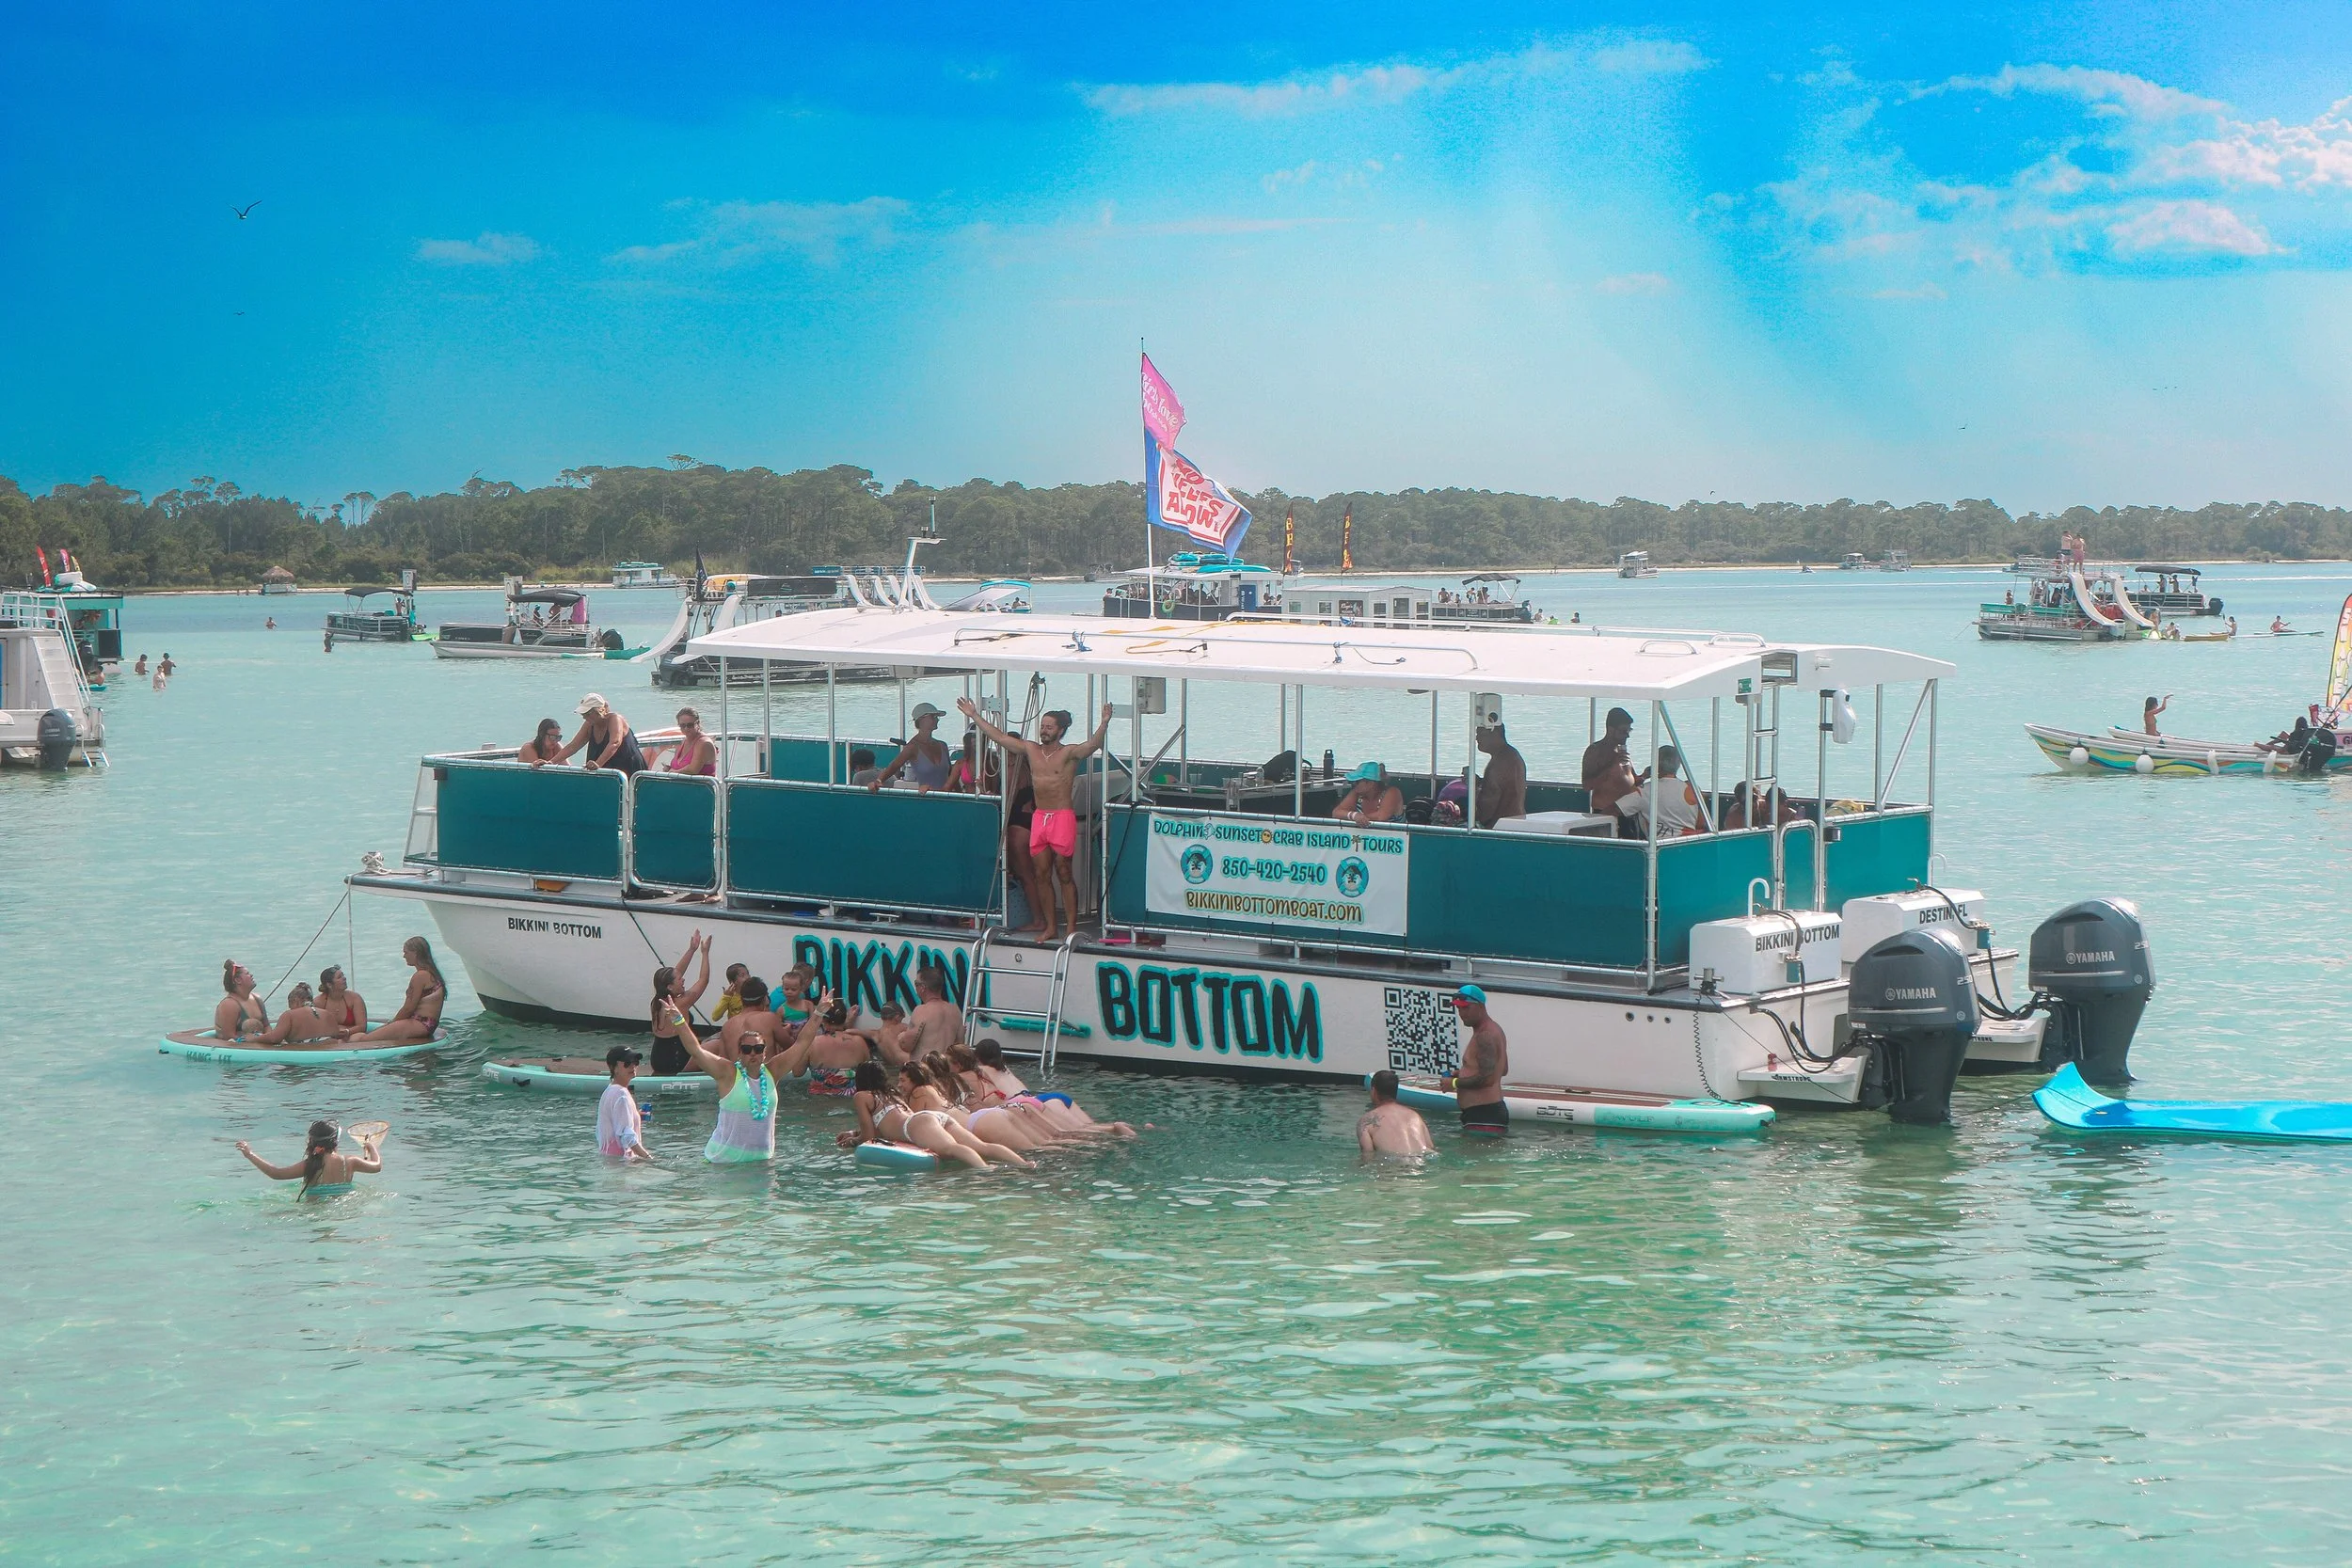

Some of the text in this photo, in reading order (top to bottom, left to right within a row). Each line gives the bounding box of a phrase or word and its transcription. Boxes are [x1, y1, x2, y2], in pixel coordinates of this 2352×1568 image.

[1153, 820, 1203, 838] DOLPHIN
[1361, 836, 1404, 854] TOURS
[1222, 858, 1327, 883] 850-420-2540
[508, 917, 602, 939] BIKKINI BOTTOM
[1756, 924, 1839, 952] BIKKINI OTTOM
[2075, 950, 2116, 964] YAMAHA
[1895, 987, 1937, 1000] YAMAHA
[1096, 961, 1323, 1063] BOTTOM
